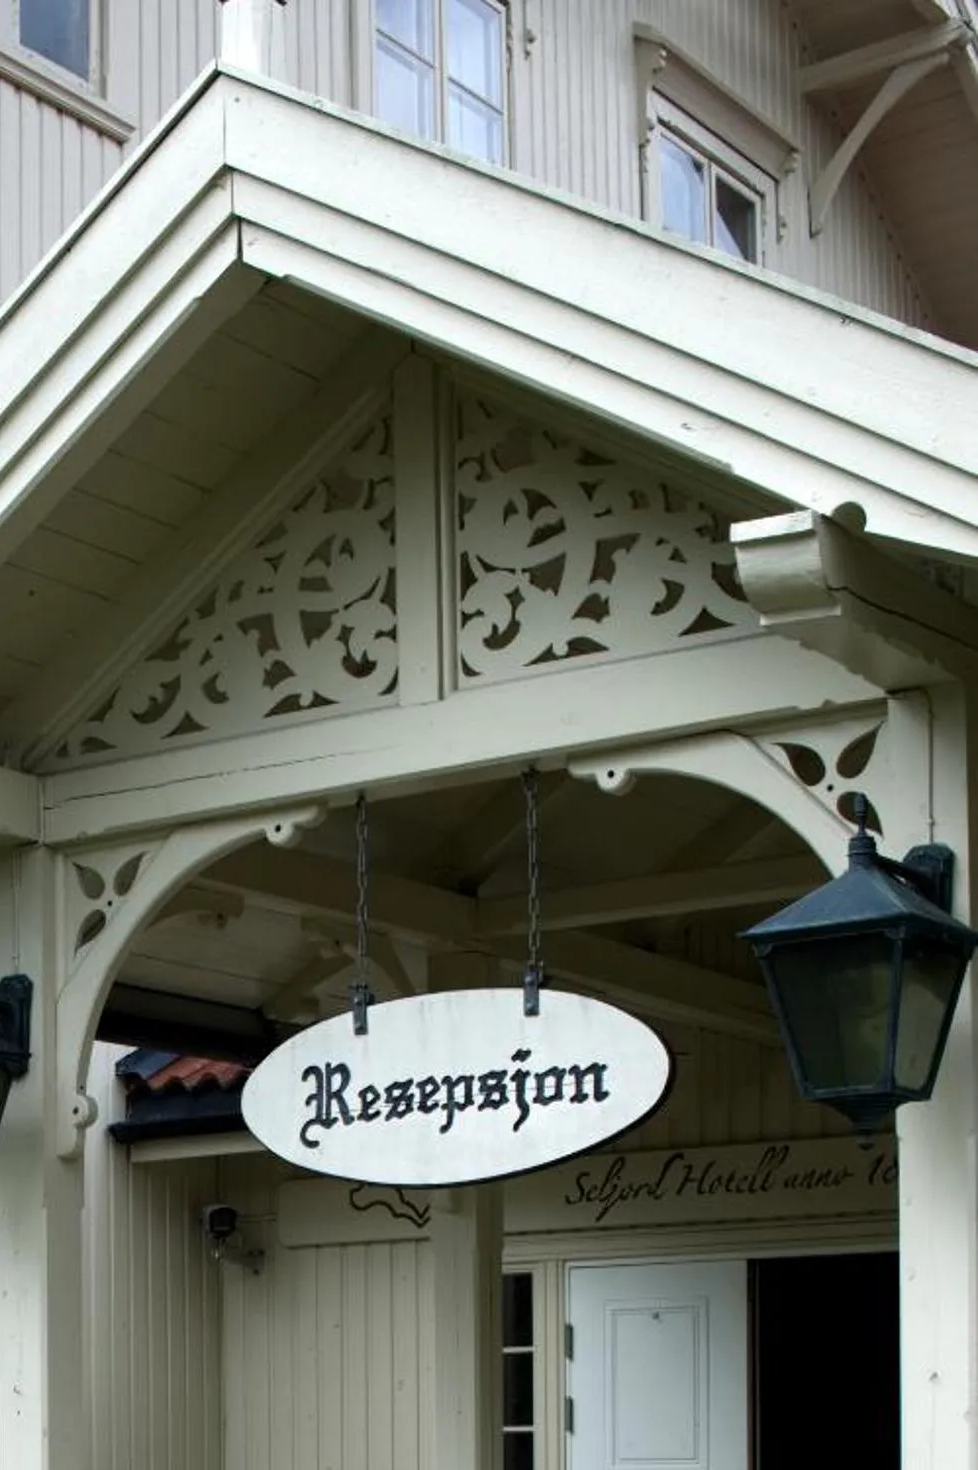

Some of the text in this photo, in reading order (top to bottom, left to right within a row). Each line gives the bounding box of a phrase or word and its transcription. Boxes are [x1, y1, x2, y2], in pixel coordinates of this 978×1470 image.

[300, 1049, 609, 1148] Resepsjon
[565, 1152, 685, 1222] Seljord
[676, 1144, 790, 1196] Hotell
[783, 1165, 854, 1190] anno
